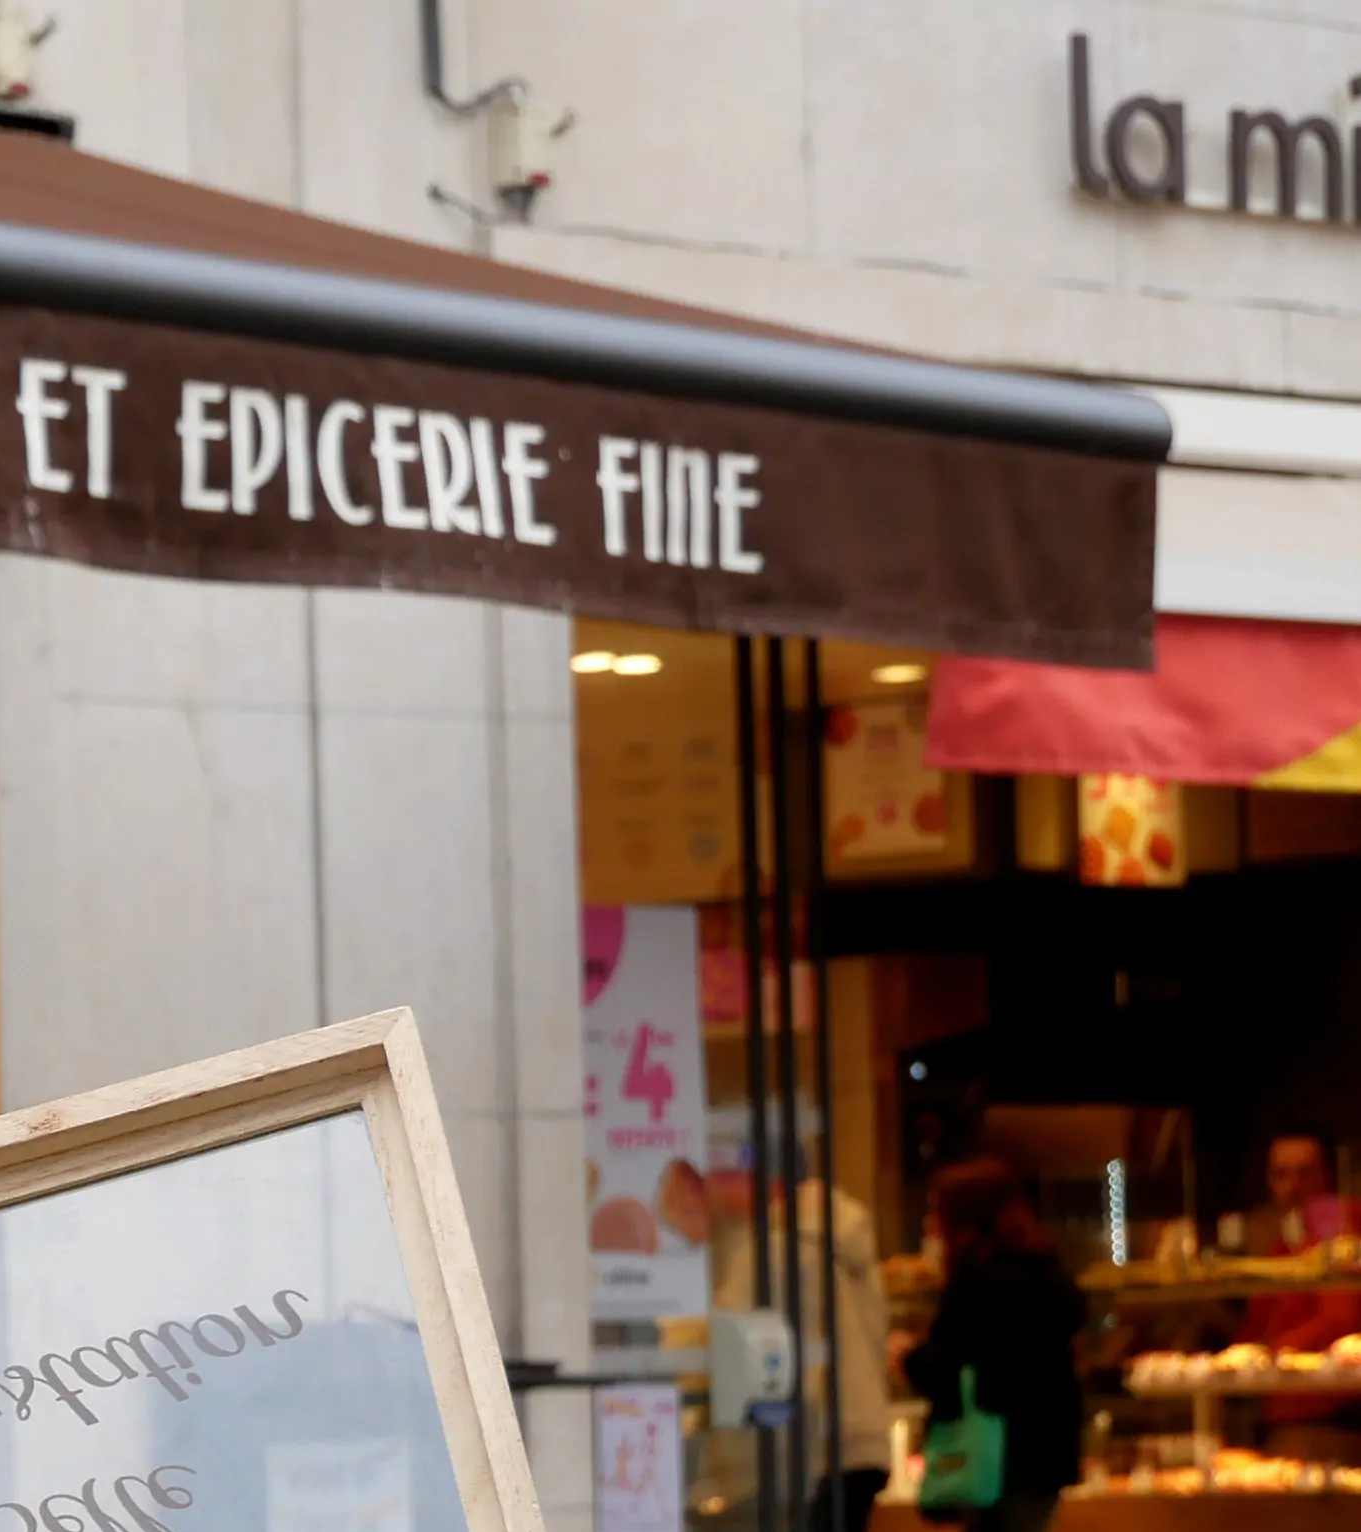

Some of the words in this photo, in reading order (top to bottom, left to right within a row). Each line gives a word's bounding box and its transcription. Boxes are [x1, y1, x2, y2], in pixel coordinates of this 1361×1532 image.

[1070, 33, 1185, 201] la
[17, 358, 127, 499] ET
[176, 379, 558, 546] EPICERIE
[597, 434, 764, 574] FINE
[622, 1022, 677, 1123] 4
